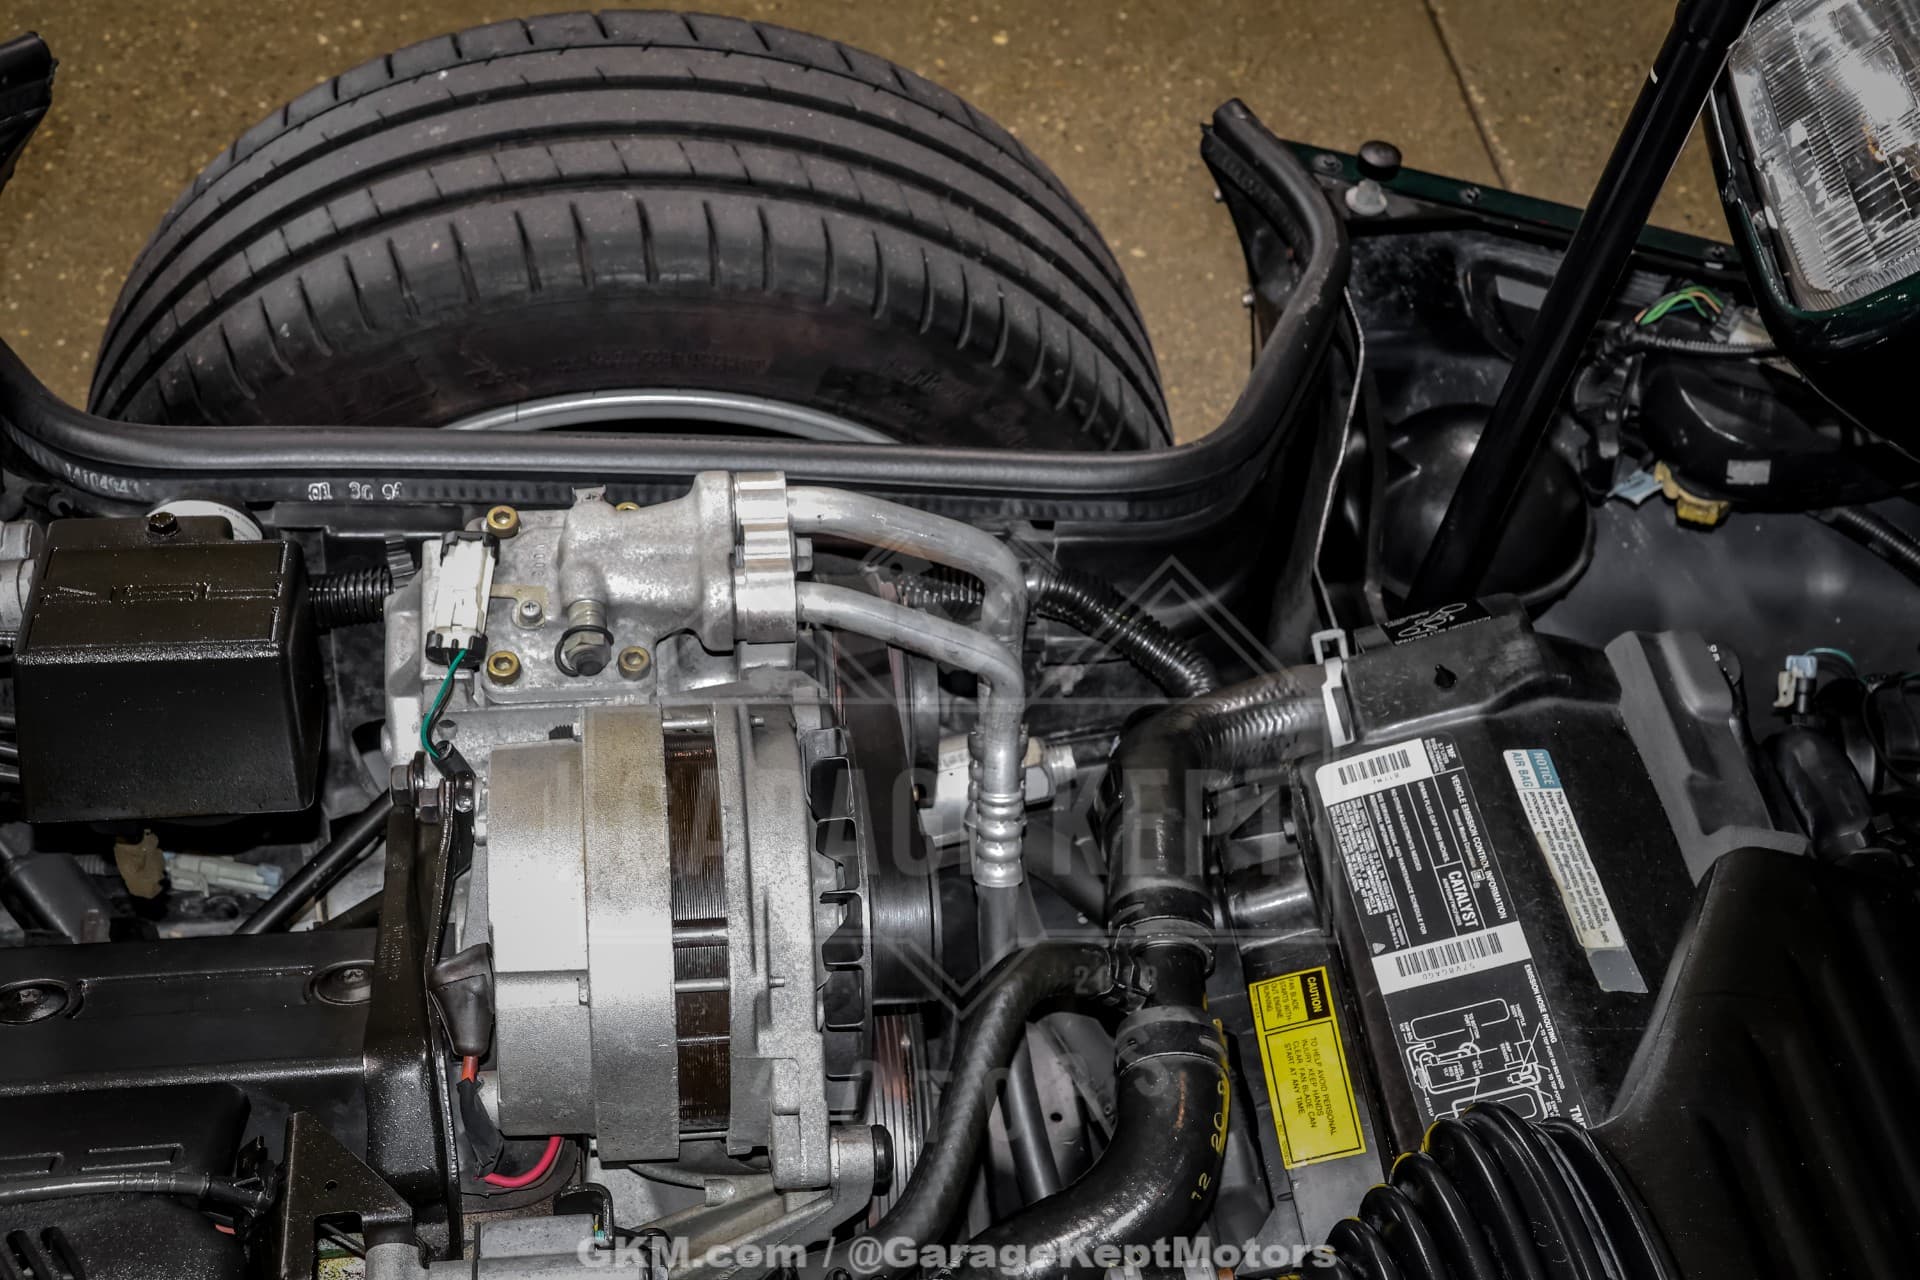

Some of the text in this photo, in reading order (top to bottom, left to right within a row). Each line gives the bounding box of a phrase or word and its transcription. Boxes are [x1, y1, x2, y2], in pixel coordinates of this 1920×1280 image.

[1510, 751, 1534, 787] AIR BAG
[1532, 752, 1555, 784] NOTICE
[1368, 794, 1383, 823] ADDITIONAL
[1423, 798, 1434, 814] PLUG
[1527, 791, 1548, 828] procedures
[1544, 791, 1561, 816] system.
[1554, 791, 1565, 805] This
[1378, 802, 1391, 824] SERVICE
[1428, 814, 1438, 826] GAP
[1555, 818, 1565, 826] To
[1560, 806, 1575, 829] vehicle
[1386, 824, 1398, 845] MANUAL
[1397, 813, 1415, 850] ADJUSTMENTS
[1409, 849, 1423, 872] NEEDED
[1543, 830, 1558, 851] before
[1558, 827, 1571, 841] help
[1393, 845, 1402, 857] AND
[1450, 774, 1508, 919] VEHICLE EMISSION CONTROL INFORMATION
[1565, 843, 1579, 862] avoid
[1570, 838, 1591, 870] equipped
[1537, 791, 1596, 929] service manual for diagnostic and service
[1550, 853, 1572, 890] performing
[1396, 857, 1414, 894] MAINTENANCE
[1573, 863, 1592, 896] unwanted
[1585, 871, 1597, 885] with
[1446, 869, 1480, 929] CATALYST
[1566, 892, 1578, 903] any
[1591, 886, 1600, 895] an
[1595, 897, 1605, 906] air
[1408, 893, 1424, 923] SCHEDULE
[1598, 908, 1611, 921] bag
[1418, 922, 1427, 935] FOR
[1599, 930, 1609, 942] see
[1270, 982, 1284, 1018] OUT ENGINE
[1278, 980, 1289, 1002] STARTS
[1287, 978, 1300, 1010] FAN BLADE
[1306, 975, 1323, 1012] CAUTION
[1514, 1003, 1526, 1026] THROTTLE
[1523, 963, 1557, 1043] EMISSION HOSE ROUTING
[1467, 1012, 1480, 1039] TO BOTTOM
[1283, 1042, 1294, 1065] START
[1288, 1066, 1296, 1076] AT
[1298, 1067, 1307, 1082] FAN
[1307, 1067, 1317, 1087] KEEP
[1552, 1066, 1565, 1089] SOLENOID
[1291, 1078, 1300, 1094] ANY
[1301, 1084, 1313, 1109] BLADE
[1309, 1036, 1337, 1136] TO HELP AVOID PERSONAL
[1553, 1090, 1562, 1103] PORT
[1311, 1088, 1324, 1116] HANDS
[1307, 1110, 1317, 1128] CAN
